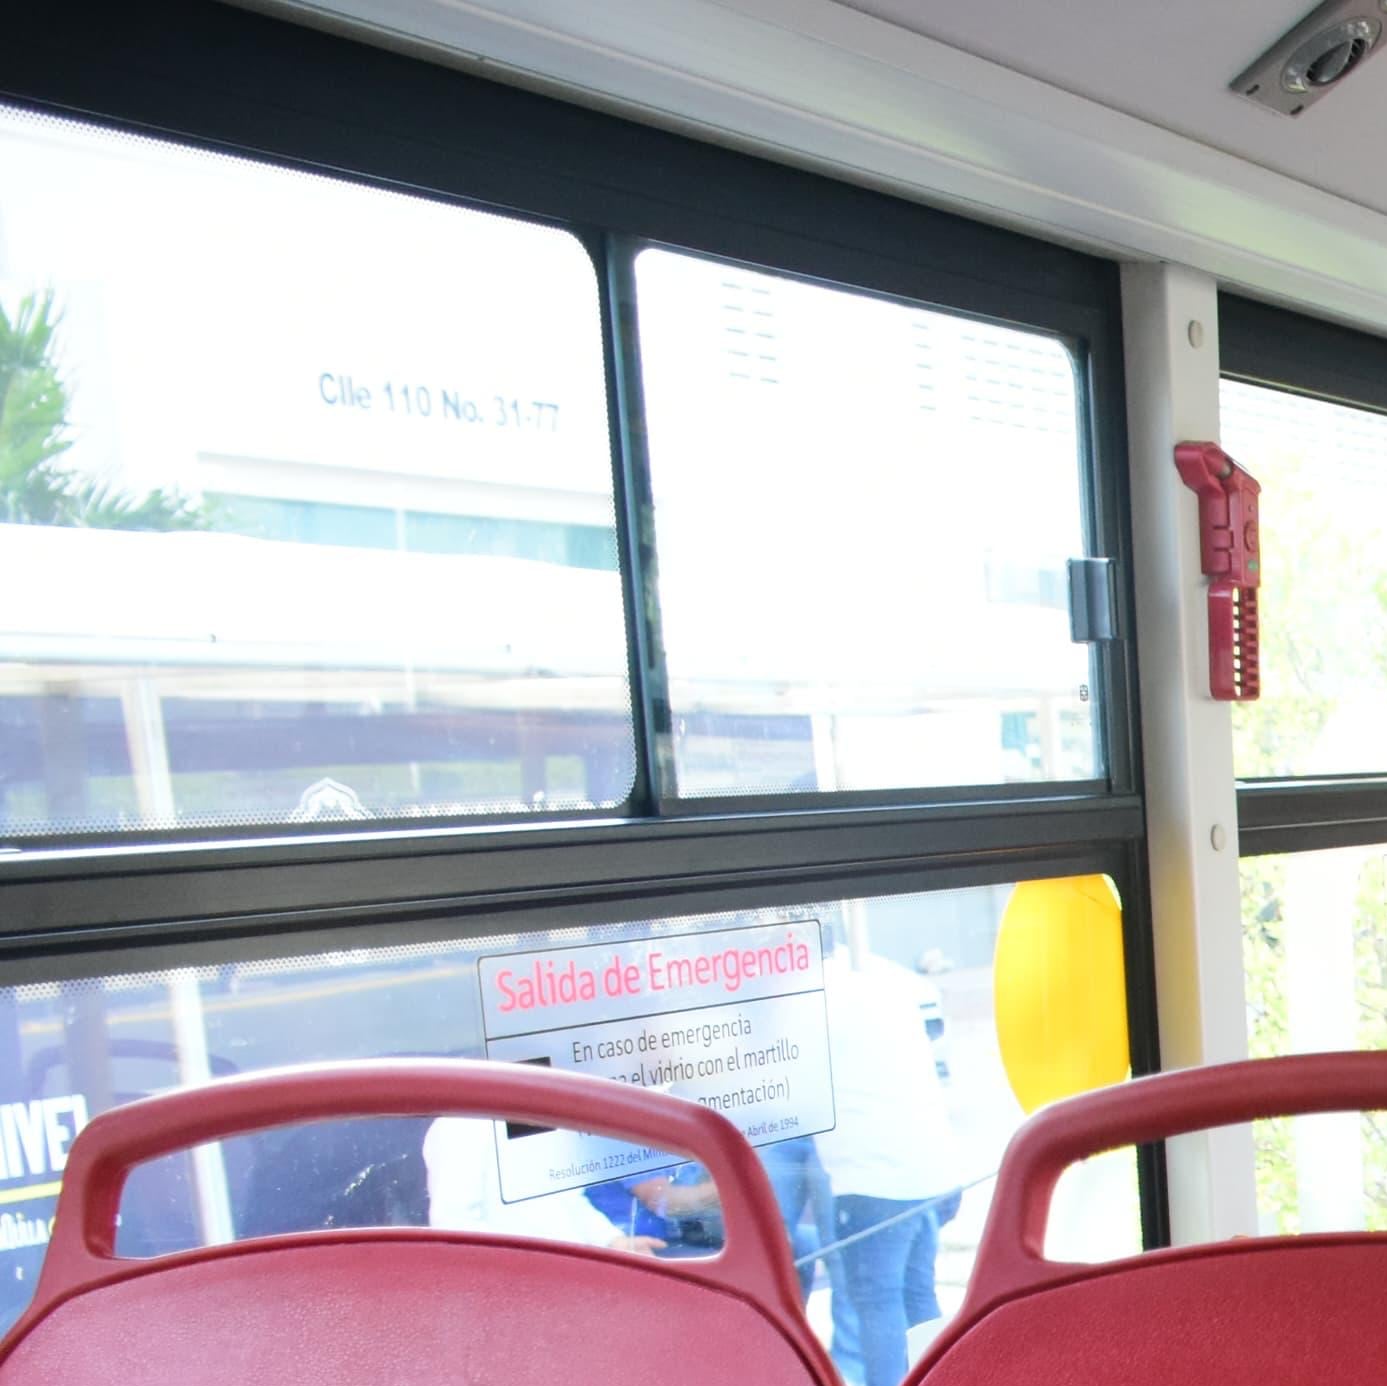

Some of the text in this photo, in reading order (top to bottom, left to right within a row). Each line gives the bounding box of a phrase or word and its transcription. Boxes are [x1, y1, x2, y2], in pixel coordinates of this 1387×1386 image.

[385, 381, 432, 417] 110
[442, 389, 484, 423] No.
[496, 932, 810, 1014] Salida de Emergencia
[572, 1014, 752, 1063] En caso de emergencia
[649, 1057, 695, 1086] vidrio
[698, 1056, 724, 1077] con
[727, 1049, 741, 1072] el
[743, 1040, 800, 1070] martillo
[780, 1116, 799, 1131] 1994
[603, 1152, 626, 1170] 1222
[627, 1149, 643, 1165] del
